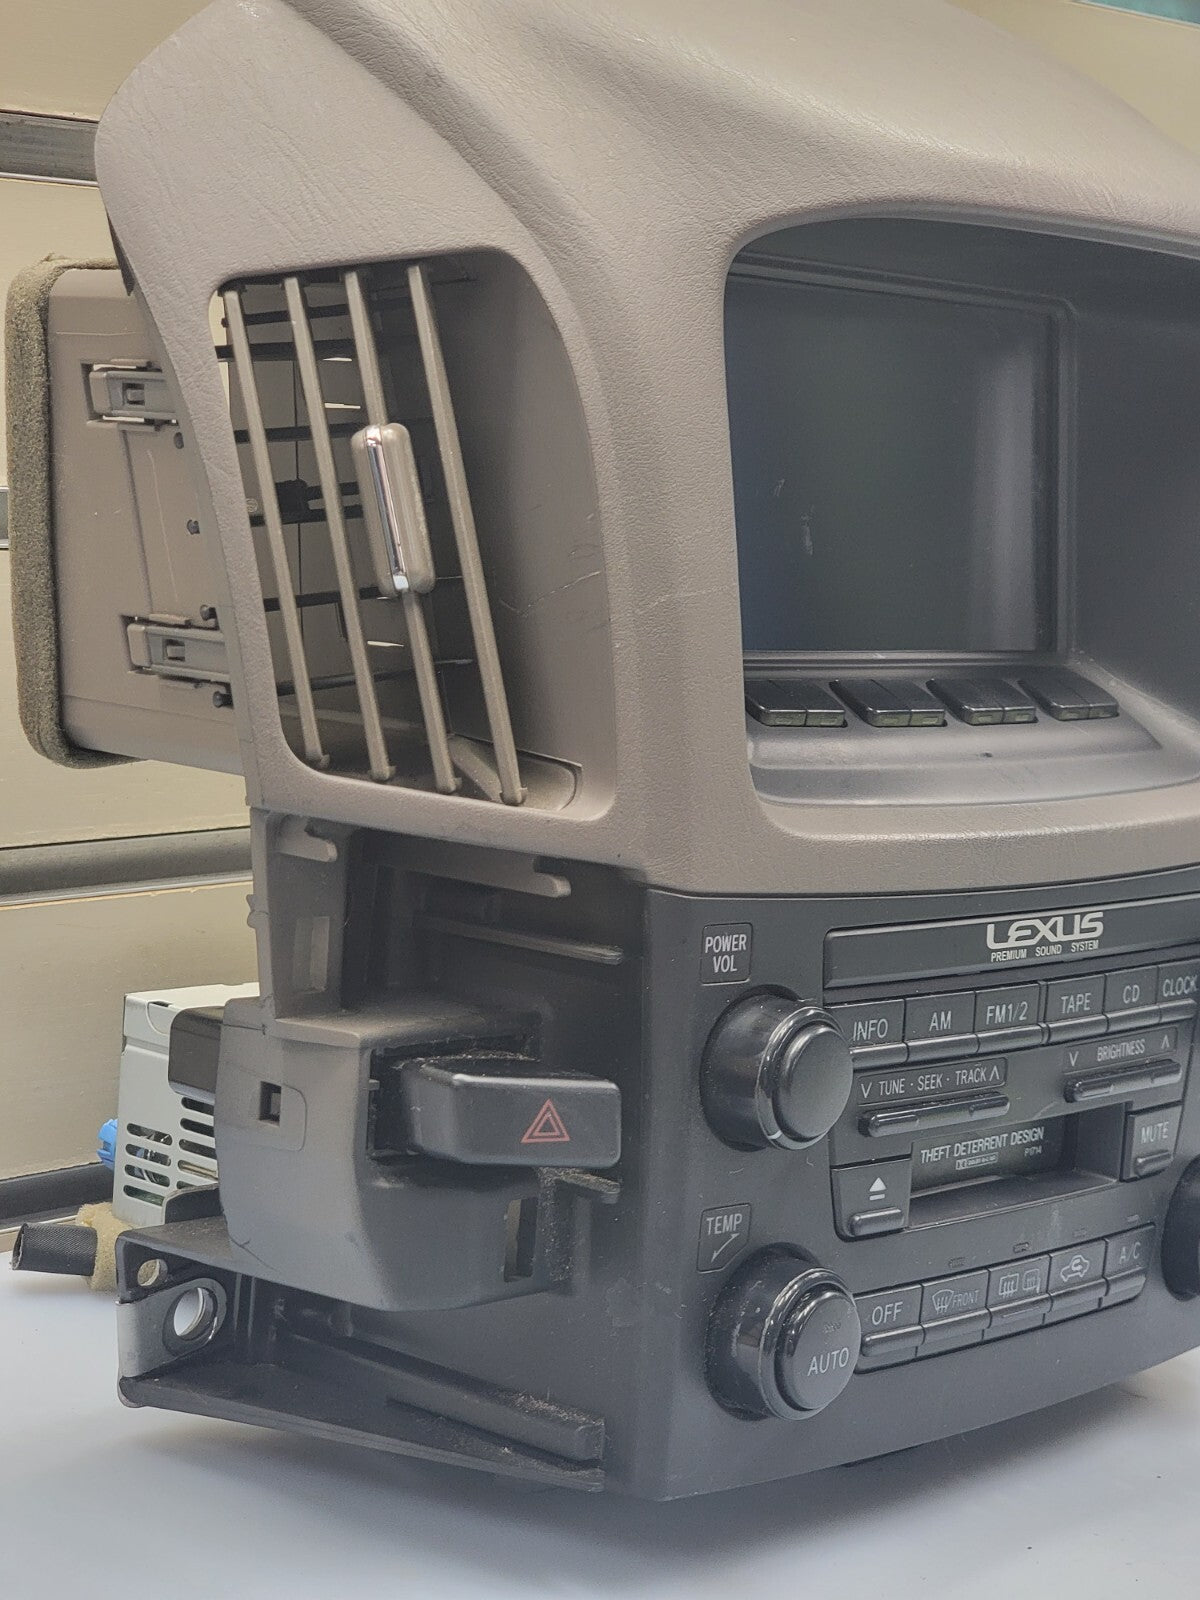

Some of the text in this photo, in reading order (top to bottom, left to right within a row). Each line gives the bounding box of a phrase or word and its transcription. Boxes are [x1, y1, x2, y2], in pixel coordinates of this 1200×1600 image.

[986, 911, 1104, 950] LEXUS
[705, 934, 747, 954] POWER
[990, 940, 1099, 963] PREMIUM SOUND SYSTEM
[713, 954, 738, 974] VOL
[1122, 984, 1140, 1004] CD
[1162, 974, 1198, 997] CLOCK
[986, 1001, 1029, 1026] FM1/2
[1061, 992, 1091, 1014] TAPE
[852, 1018, 889, 1042] INFO
[929, 1010, 952, 1032] AM
[1096, 1038, 1146, 1062] BRIGHTNESS
[878, 1066, 987, 1096] TUNE SEEK TRACK
[920, 1144, 951, 1164] THEFT
[953, 1134, 1008, 1157] DETERRENT
[1010, 1126, 1045, 1146] DESIGN
[1140, 1121, 1170, 1145] MUTE
[706, 1213, 743, 1235] TEMP
[1118, 1241, 1142, 1265] A/C
[953, 1289, 979, 1308] FRONT
[871, 1302, 904, 1326] OFF
[807, 1347, 850, 1377] AUTO
